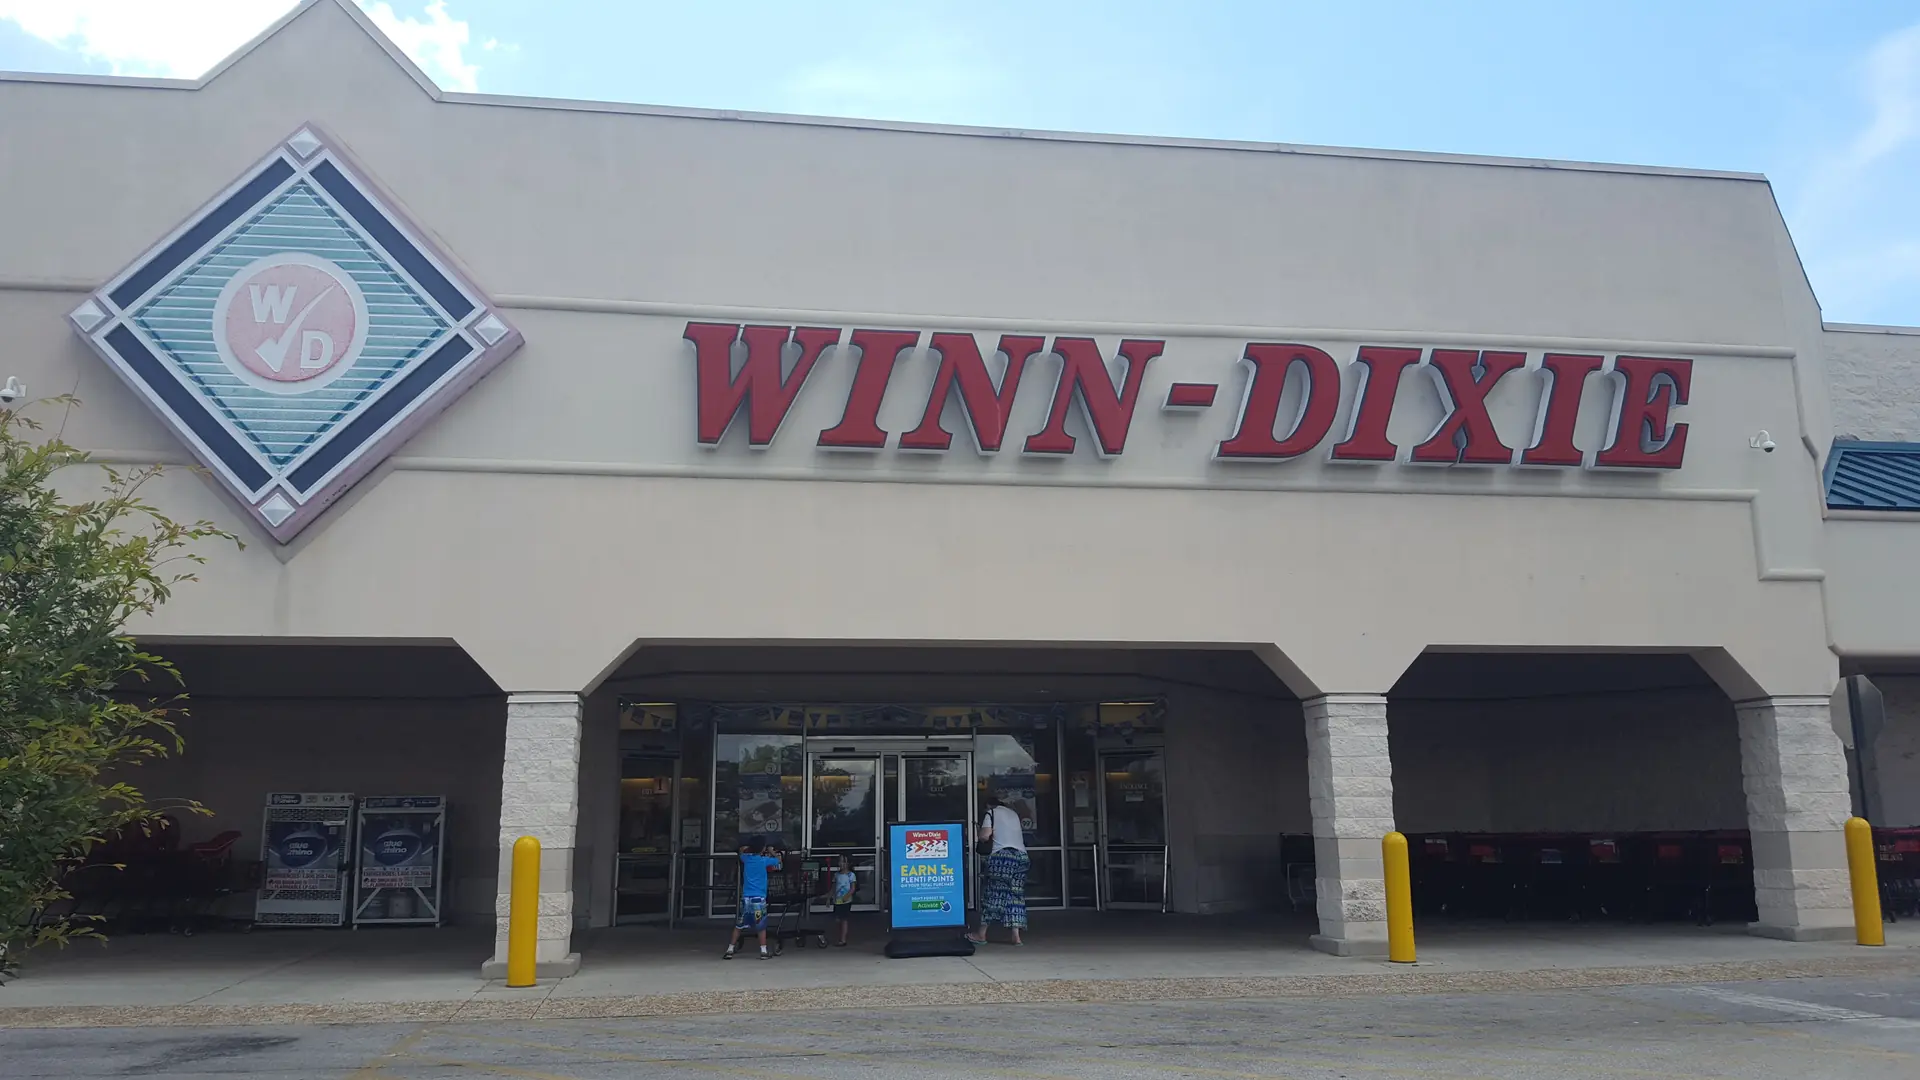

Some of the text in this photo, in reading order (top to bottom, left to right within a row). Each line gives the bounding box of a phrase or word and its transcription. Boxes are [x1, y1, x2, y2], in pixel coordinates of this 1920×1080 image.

[683, 321, 1693, 468] WINN-DIXIE
[900, 864, 937, 877] EARN
[927, 875, 954, 883] POINTS
